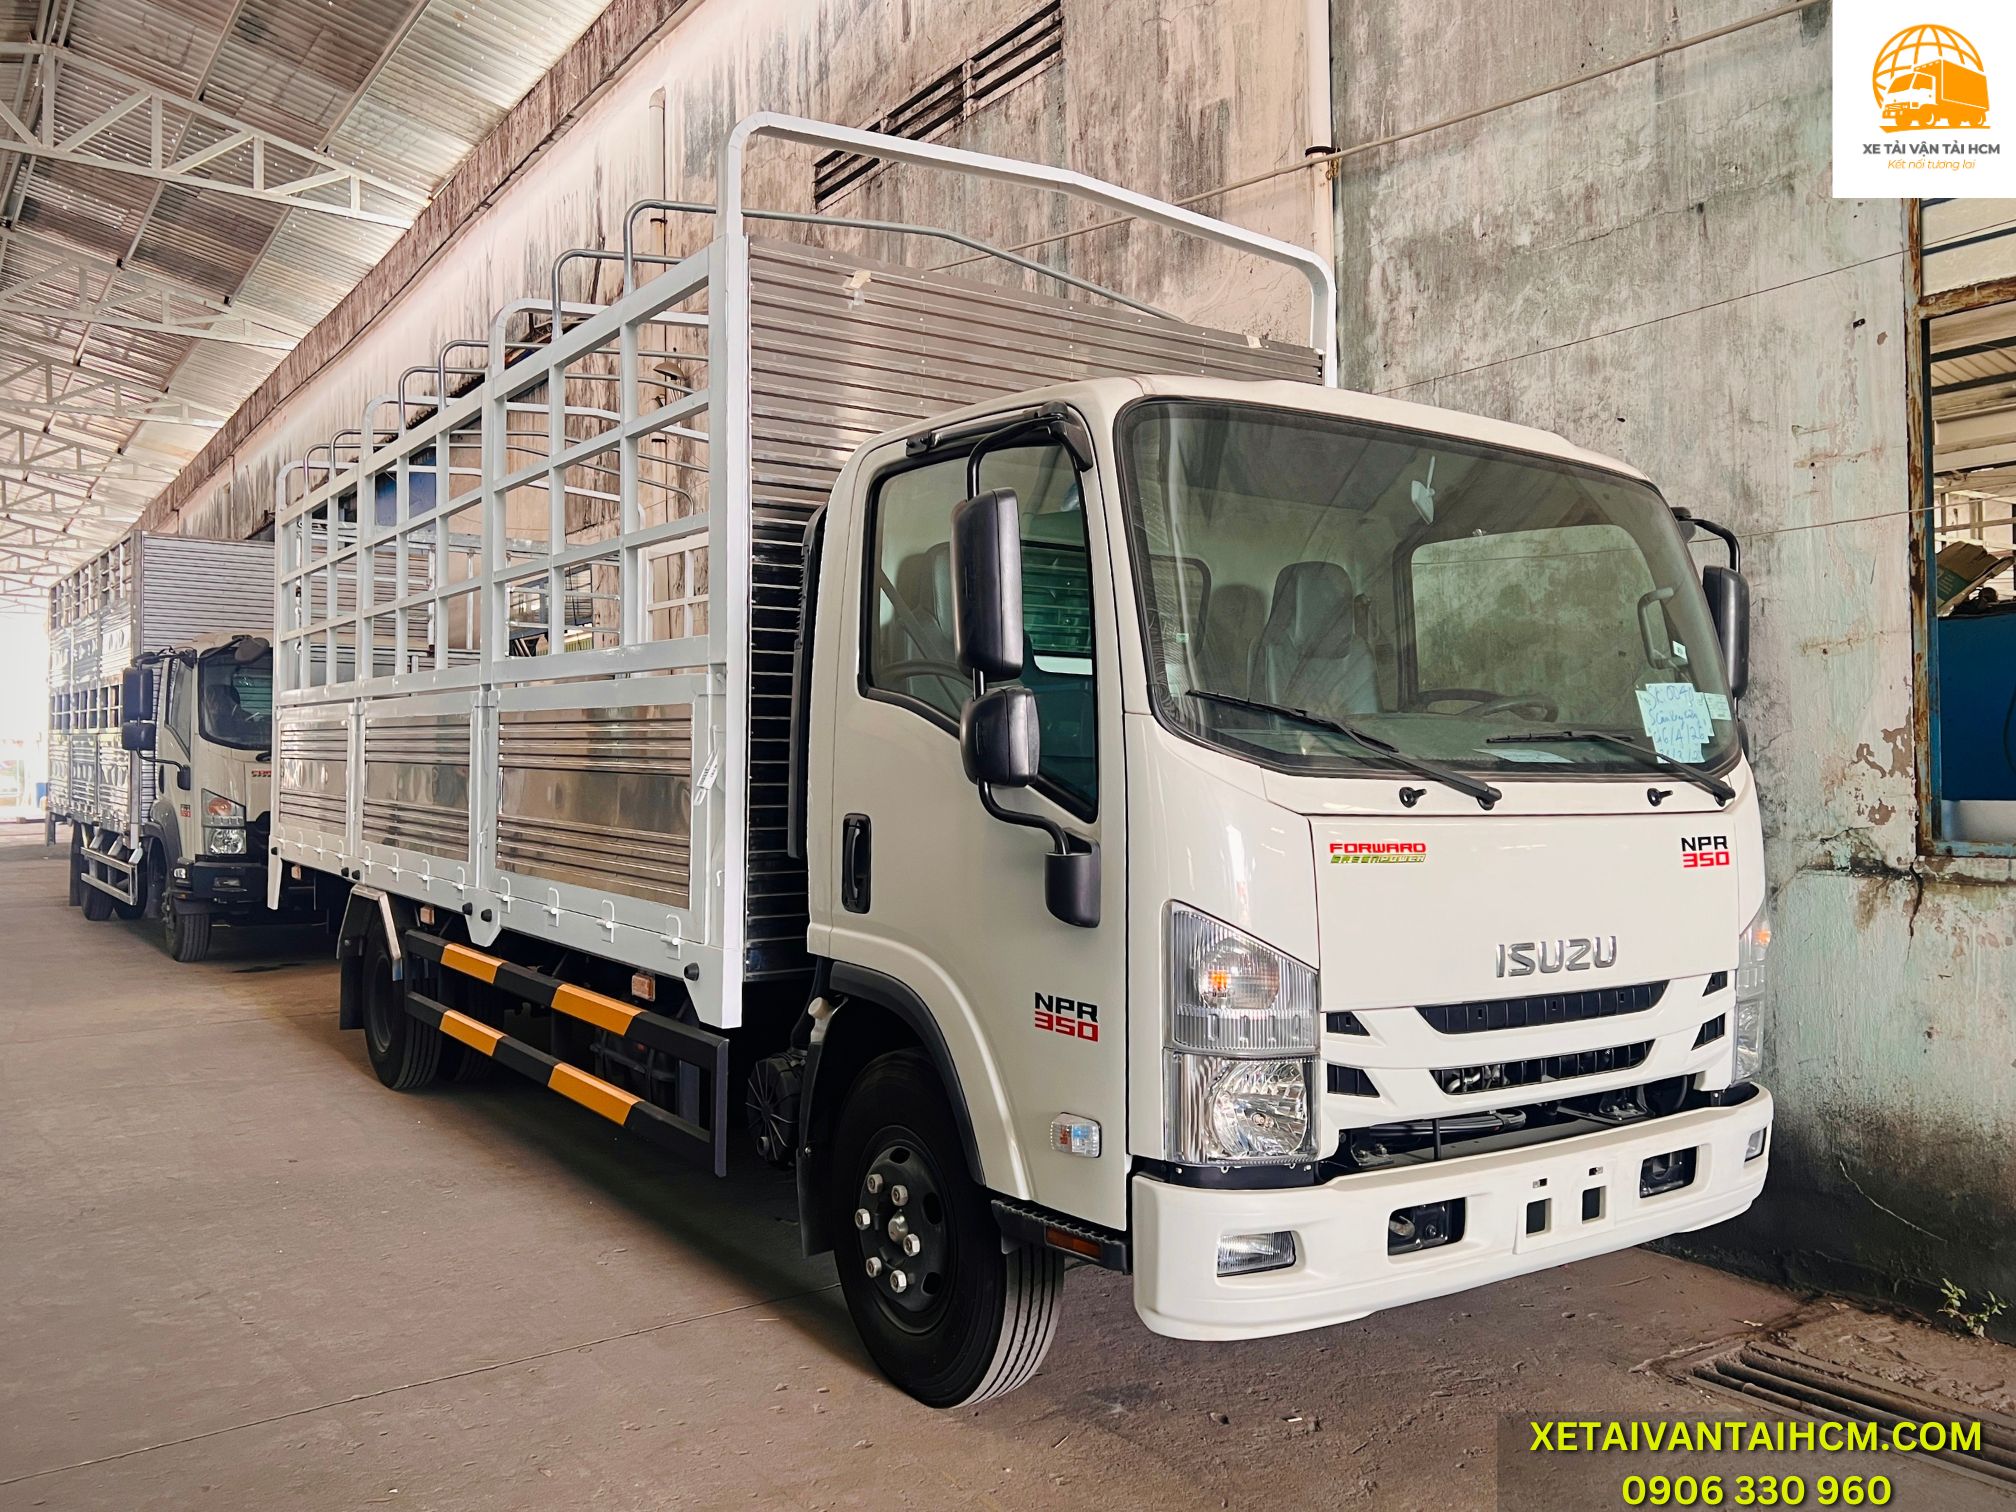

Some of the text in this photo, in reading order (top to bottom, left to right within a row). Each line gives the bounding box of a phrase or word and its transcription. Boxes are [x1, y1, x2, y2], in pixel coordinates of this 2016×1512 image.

[1329, 843, 1427, 853] FORWARD
[1681, 835, 1728, 851] NPR
[1682, 851, 1730, 868] 350
[1496, 935, 1617, 978] ISUZU
[1035, 991, 1099, 1024] NPR
[1034, 1010, 1099, 1042] 350
